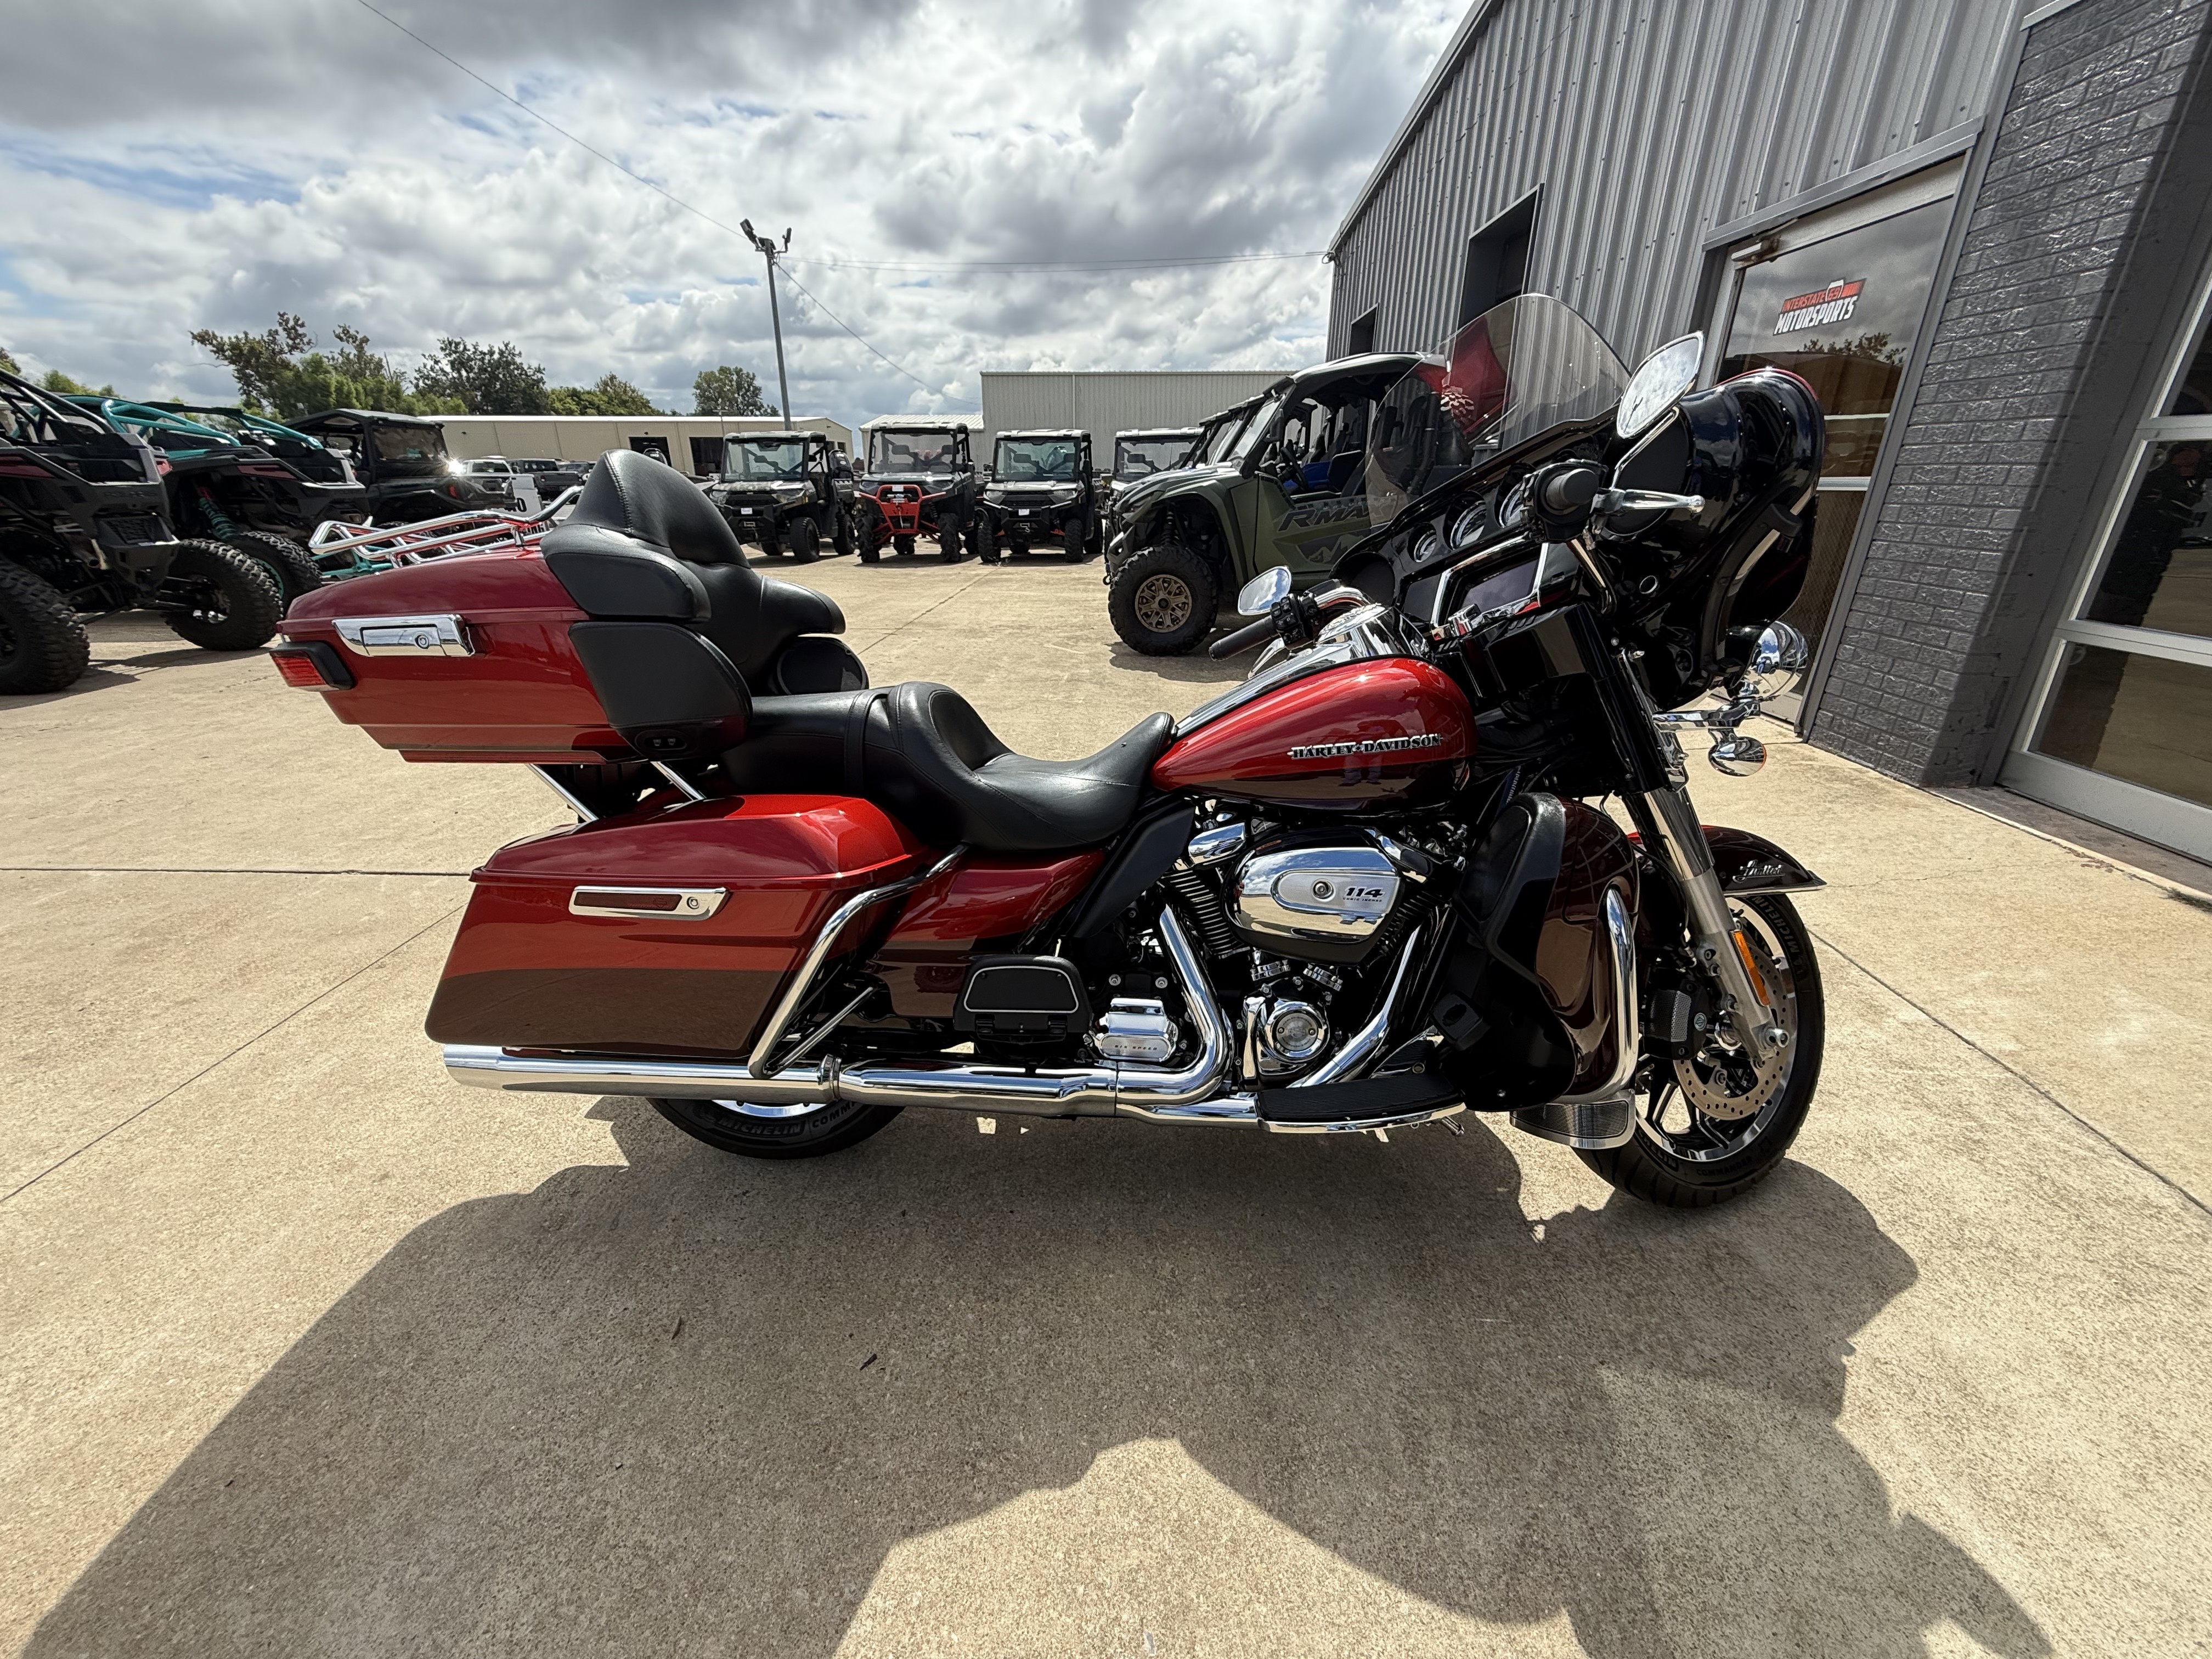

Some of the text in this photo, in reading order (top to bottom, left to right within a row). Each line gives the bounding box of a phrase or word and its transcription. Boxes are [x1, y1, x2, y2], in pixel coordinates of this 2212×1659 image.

[1782, 286, 1841, 312] INTERSTATE 69
[1773, 295, 1859, 335] MOTORSPORTS
[1345, 886, 1385, 899] 114
[1751, 895, 1800, 953] MICHELIN
[718, 1117, 801, 1136] MICHELIN
[1696, 1155, 1753, 1176] COMMANDER
